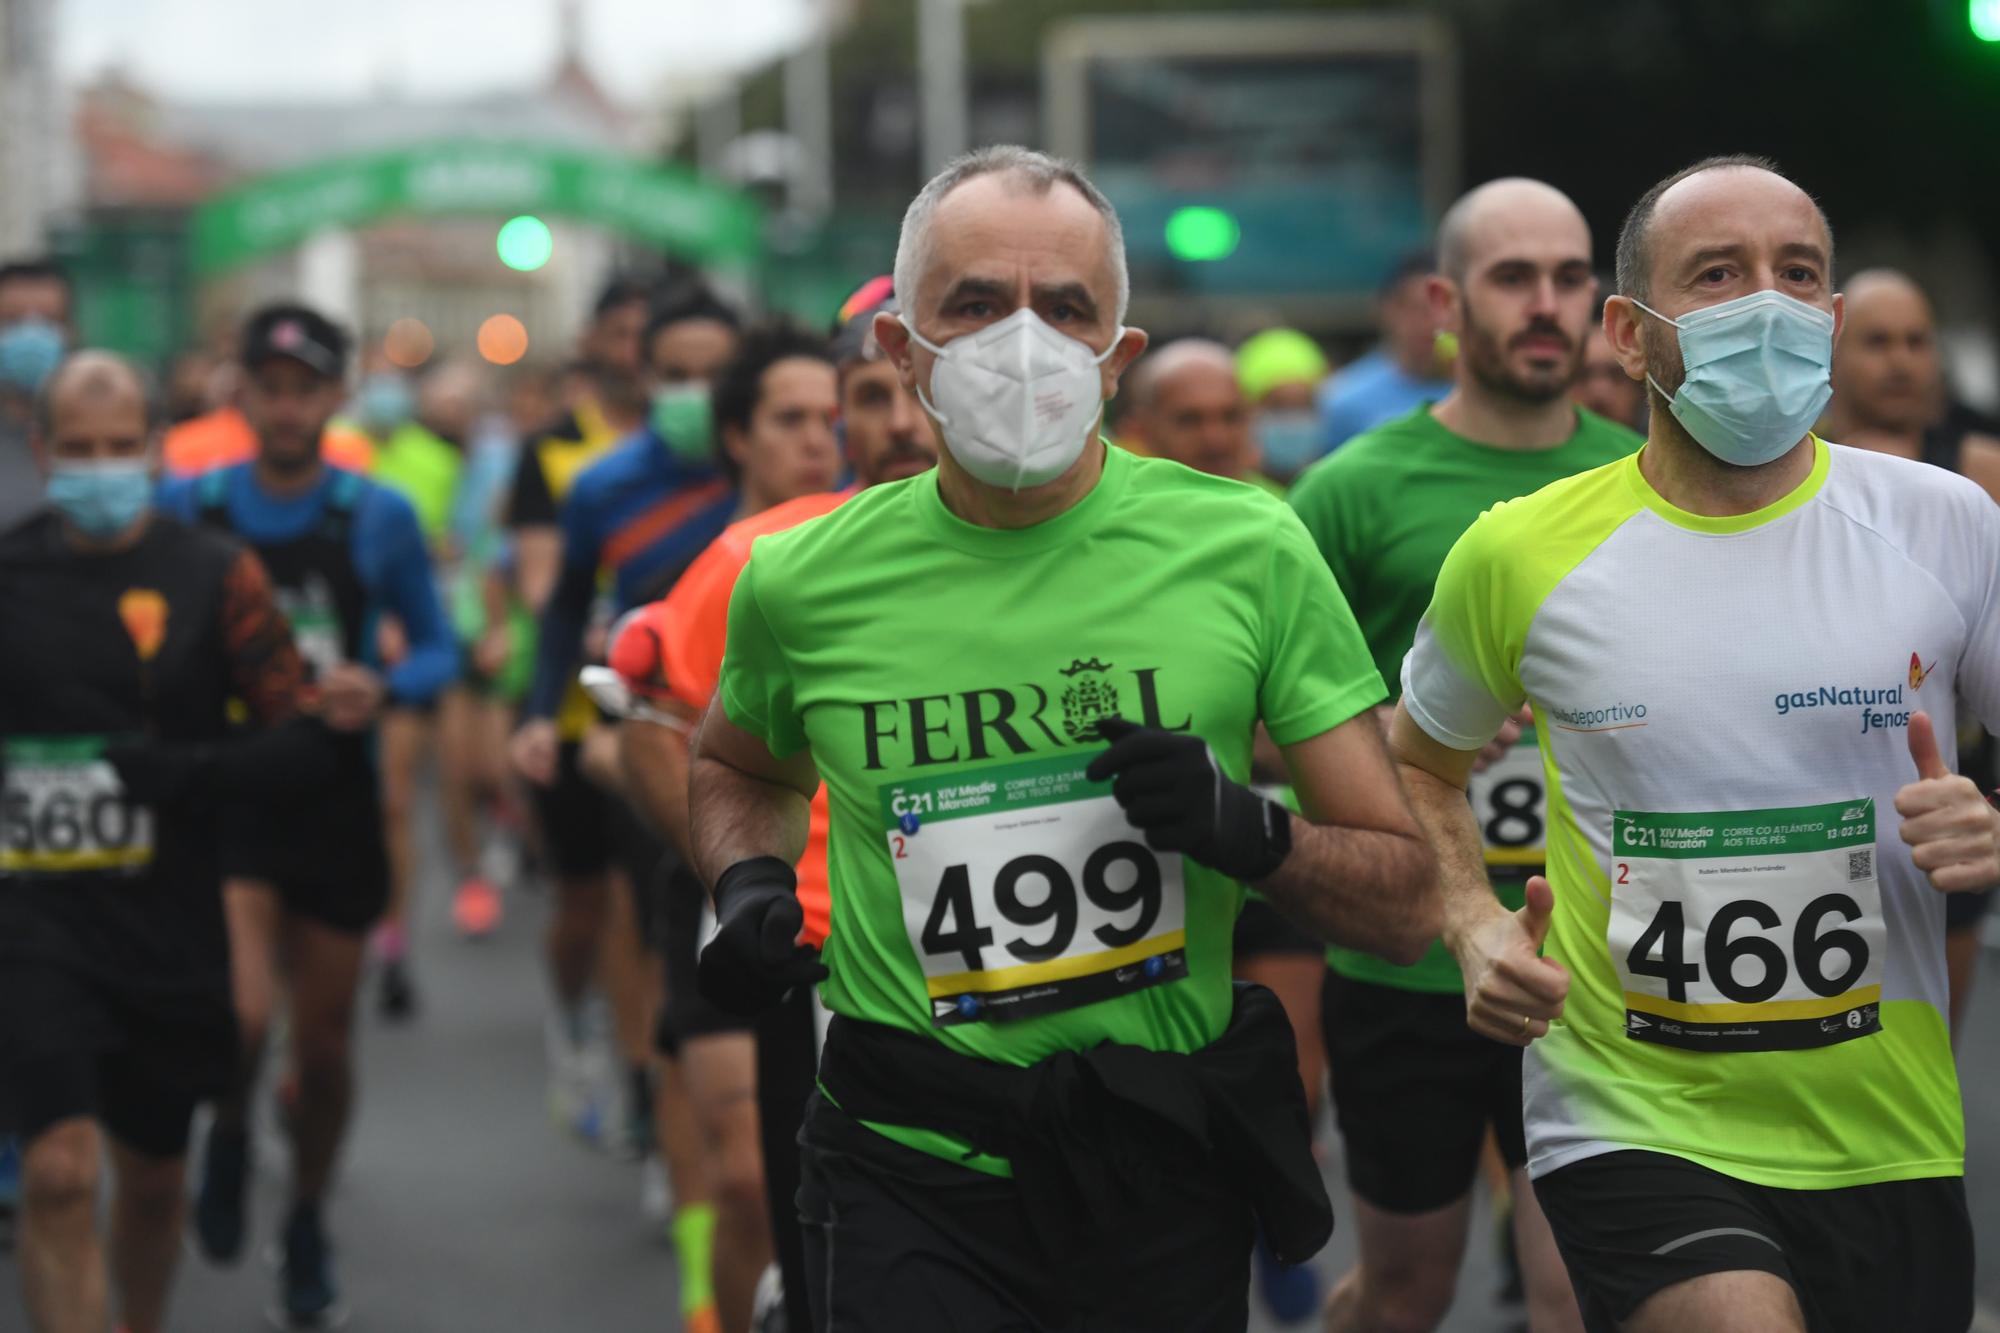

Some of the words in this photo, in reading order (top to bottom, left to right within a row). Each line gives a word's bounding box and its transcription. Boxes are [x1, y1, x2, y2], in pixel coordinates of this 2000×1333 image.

[1775, 685, 1902, 714] gasNatural
[1552, 703, 1646, 726] deportivo
[1862, 708, 1910, 734] fenos
[936, 787, 958, 800] XIV
[959, 782, 997, 797] Media
[1004, 777, 1037, 791] CORRE
[1039, 775, 1056, 787] CO
[1056, 770, 1086, 785] ATLÁN
[938, 795, 991, 811] Maratón
[1006, 788, 1027, 801] AOS
[1028, 786, 1051, 799] TEUS
[1468, 778, 1543, 847] 8
[1660, 828, 1678, 838] XIV
[1678, 826, 1714, 839] Media
[1722, 826, 1754, 838] CORRE
[1755, 825, 1772, 836] CO
[1773, 821, 1824, 835] ATLÁNTICO
[892, 836, 908, 859] 2
[1660, 838, 1707, 849] Maratón
[1723, 837, 1743, 847] AOS
[1744, 836, 1768, 846] TEUS
[1769, 834, 1787, 845] PÉS
[1616, 863, 1630, 885] 2
[920, 840, 1162, 972] 499
[1626, 893, 1870, 1004] 466
